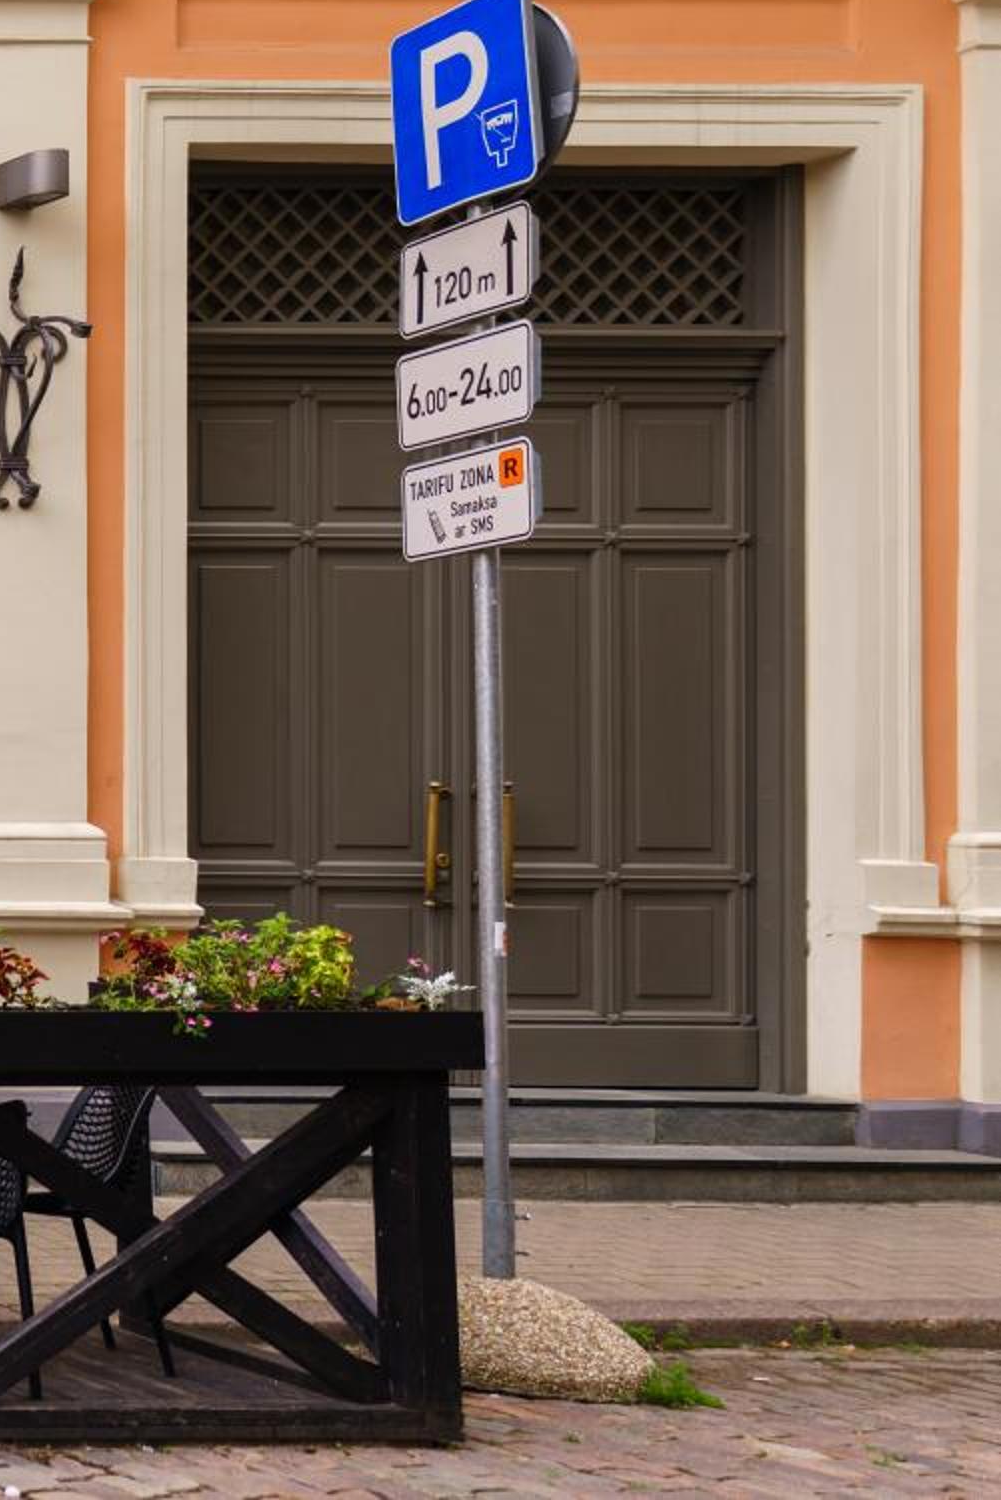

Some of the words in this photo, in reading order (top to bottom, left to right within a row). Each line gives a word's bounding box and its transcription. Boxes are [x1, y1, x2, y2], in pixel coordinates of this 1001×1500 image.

[420, 31, 488, 190] P
[435, 266, 471, 308] 120
[478, 272, 495, 294] m
[407, 362, 521, 418] 6.00-24.00
[410, 473, 454, 501] TARIFU
[460, 464, 495, 489] ZONA
[503, 457, 518, 479] R
[450, 494, 497, 517] Samaksa
[455, 524, 466, 538] ar
[470, 516, 494, 534] SMS
